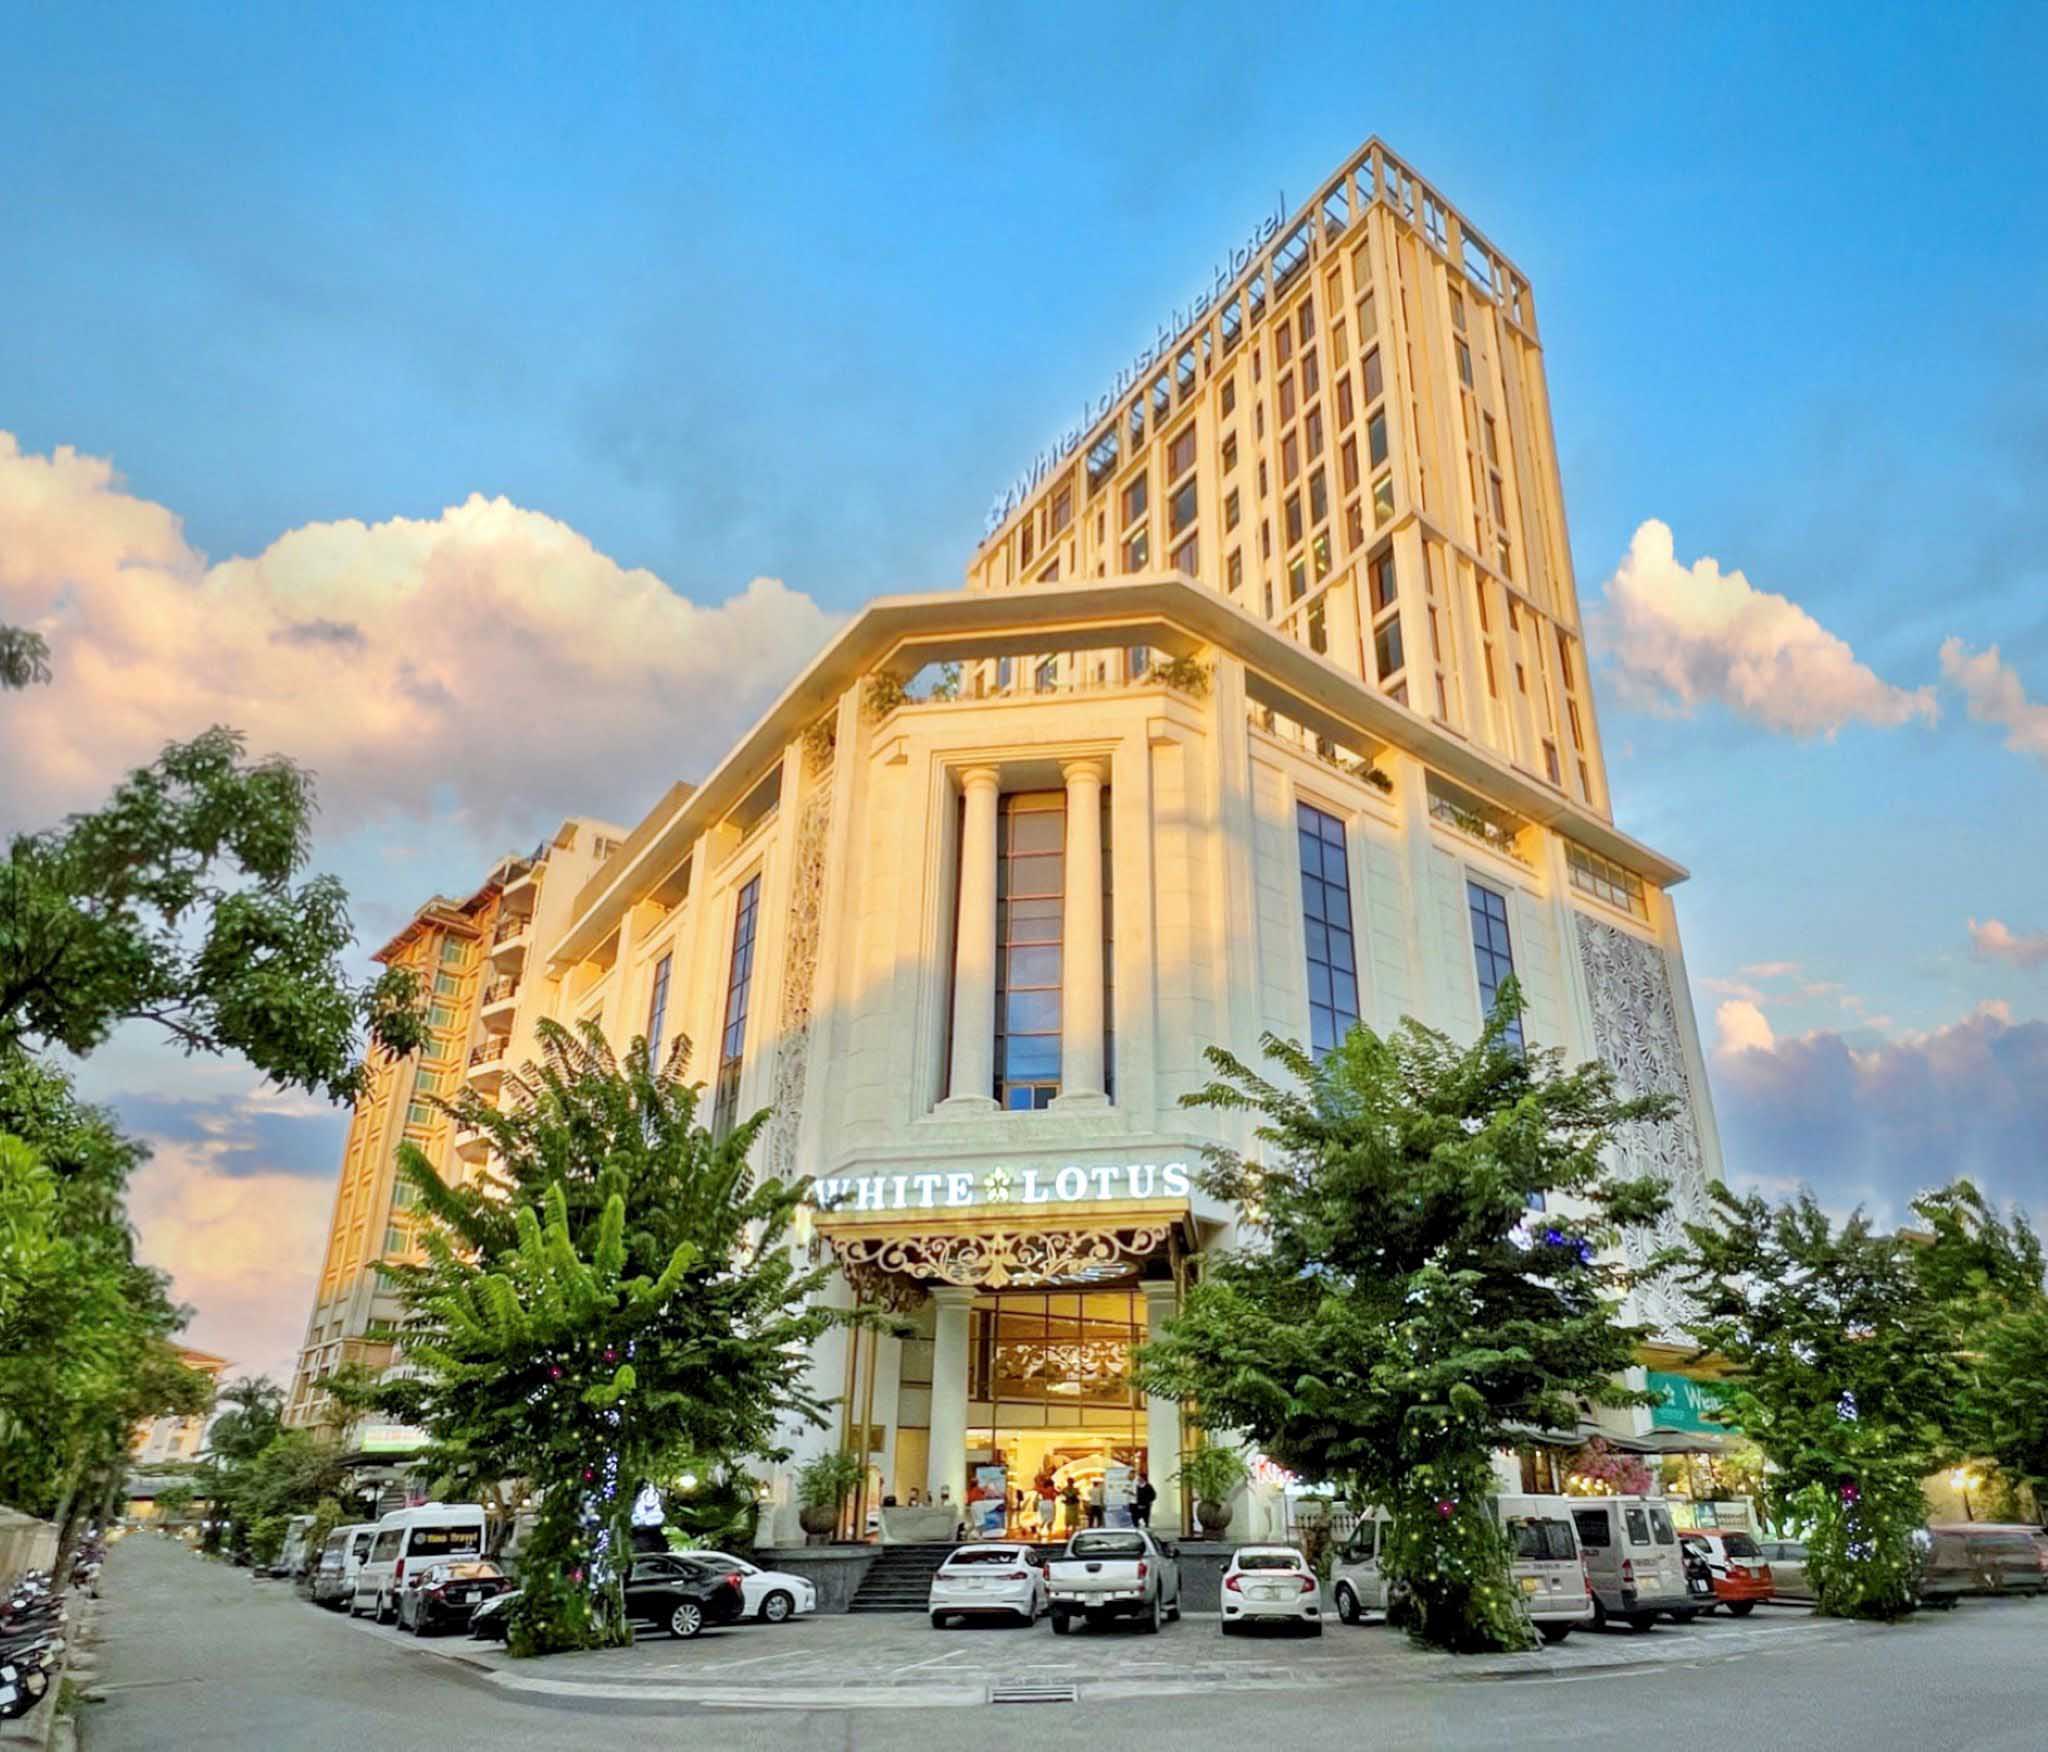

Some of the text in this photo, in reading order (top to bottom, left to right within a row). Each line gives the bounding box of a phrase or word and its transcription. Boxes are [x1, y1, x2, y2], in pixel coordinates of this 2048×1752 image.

[1014, 188, 1286, 505] White Lotus Hue Hotel
[814, 1162, 1190, 1211] WHITE LOTUS
